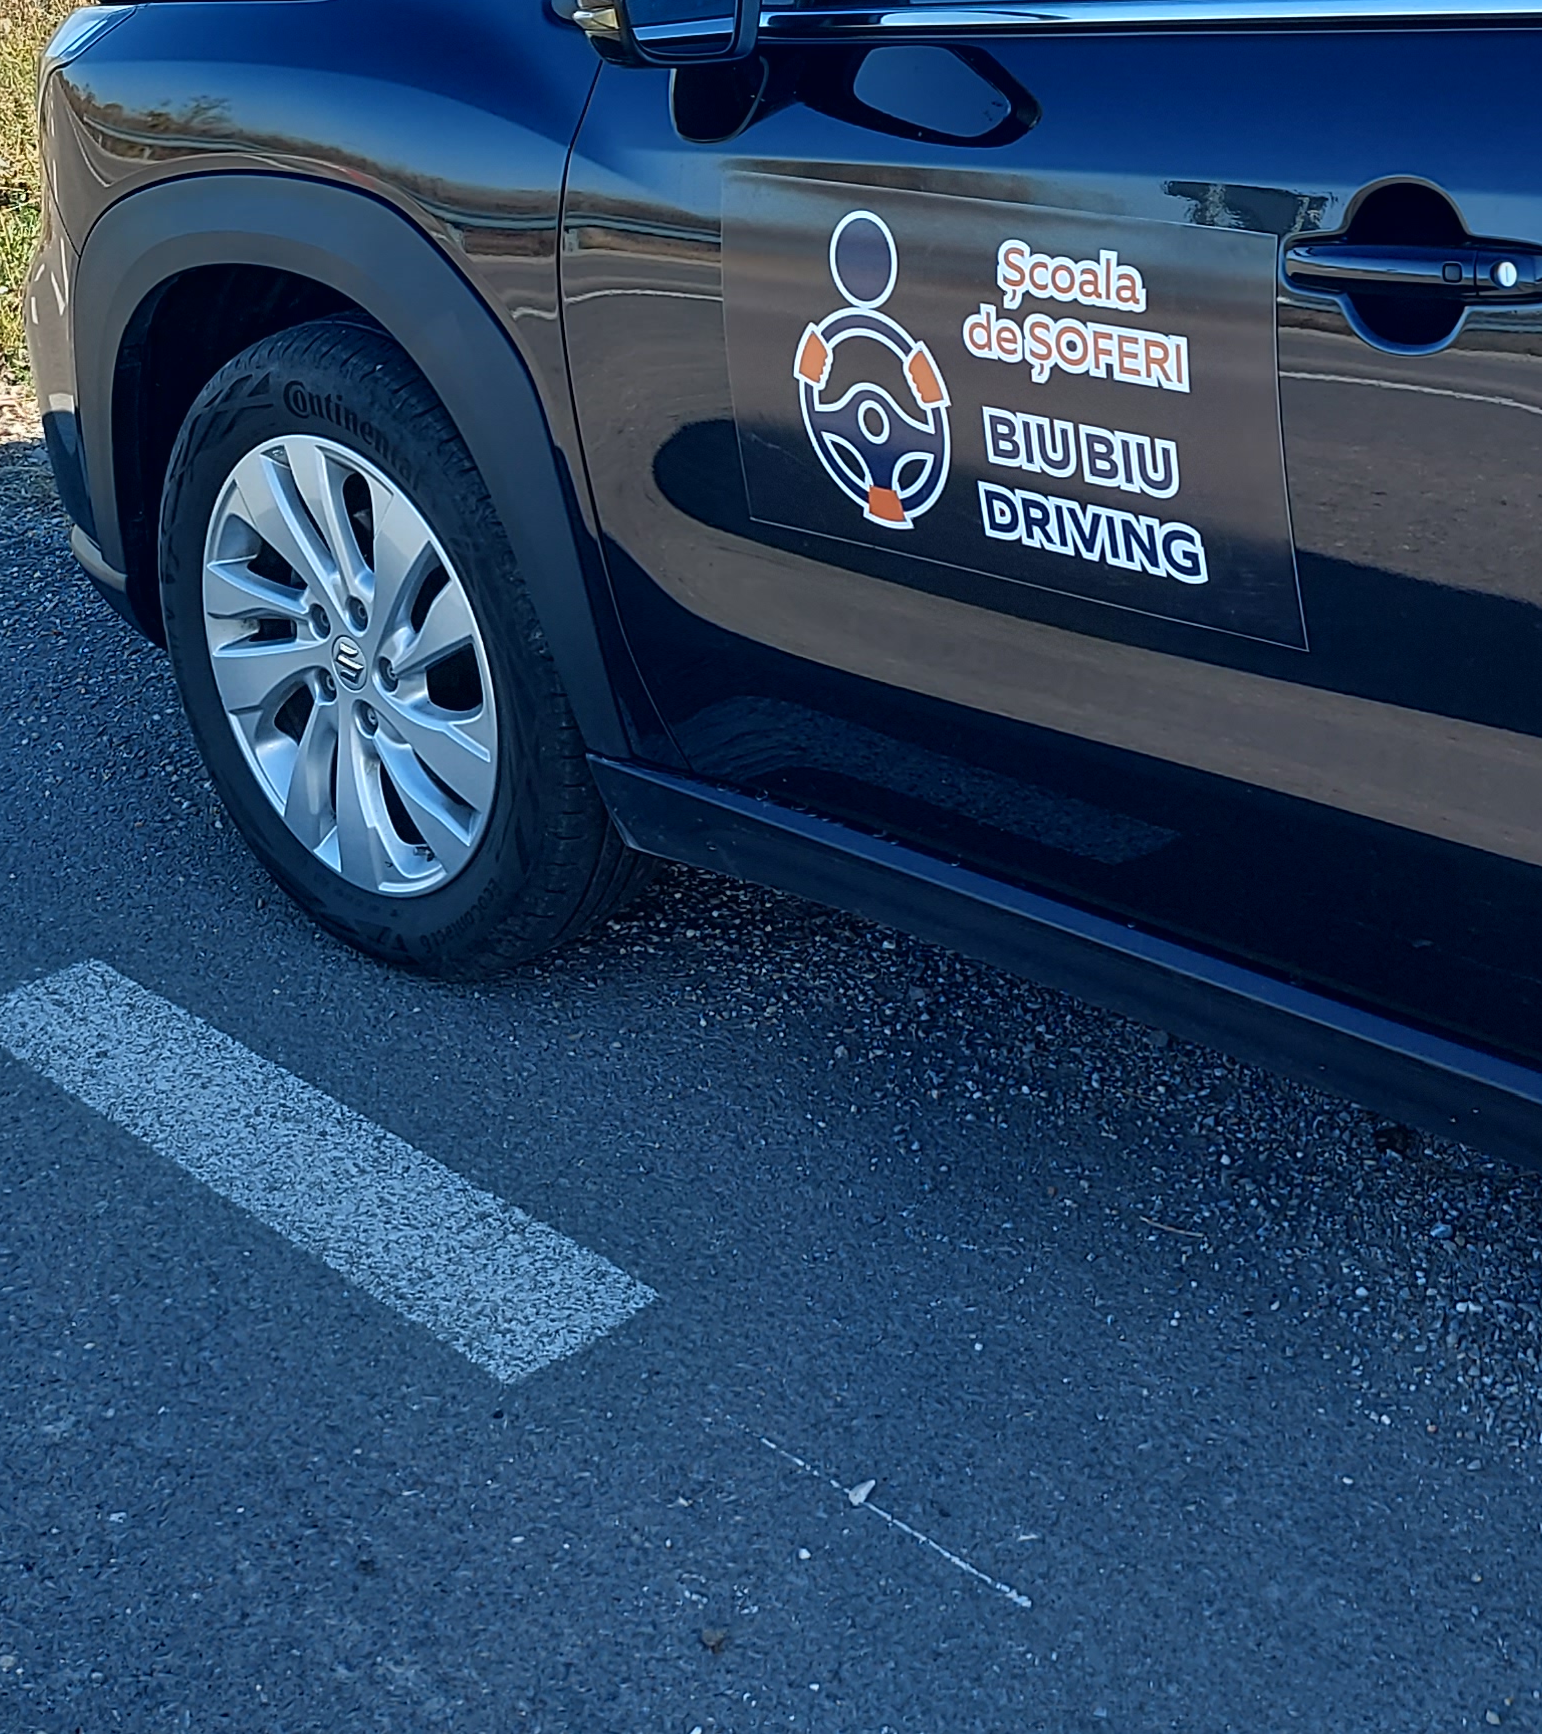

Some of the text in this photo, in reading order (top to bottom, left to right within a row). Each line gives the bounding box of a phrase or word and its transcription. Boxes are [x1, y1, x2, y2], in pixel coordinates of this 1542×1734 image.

[997, 239, 1147, 313] Școala
[282, 379, 421, 492] Continental
[982, 406, 1180, 499] BIU BIU
[977, 480, 1209, 584] DRIVING
